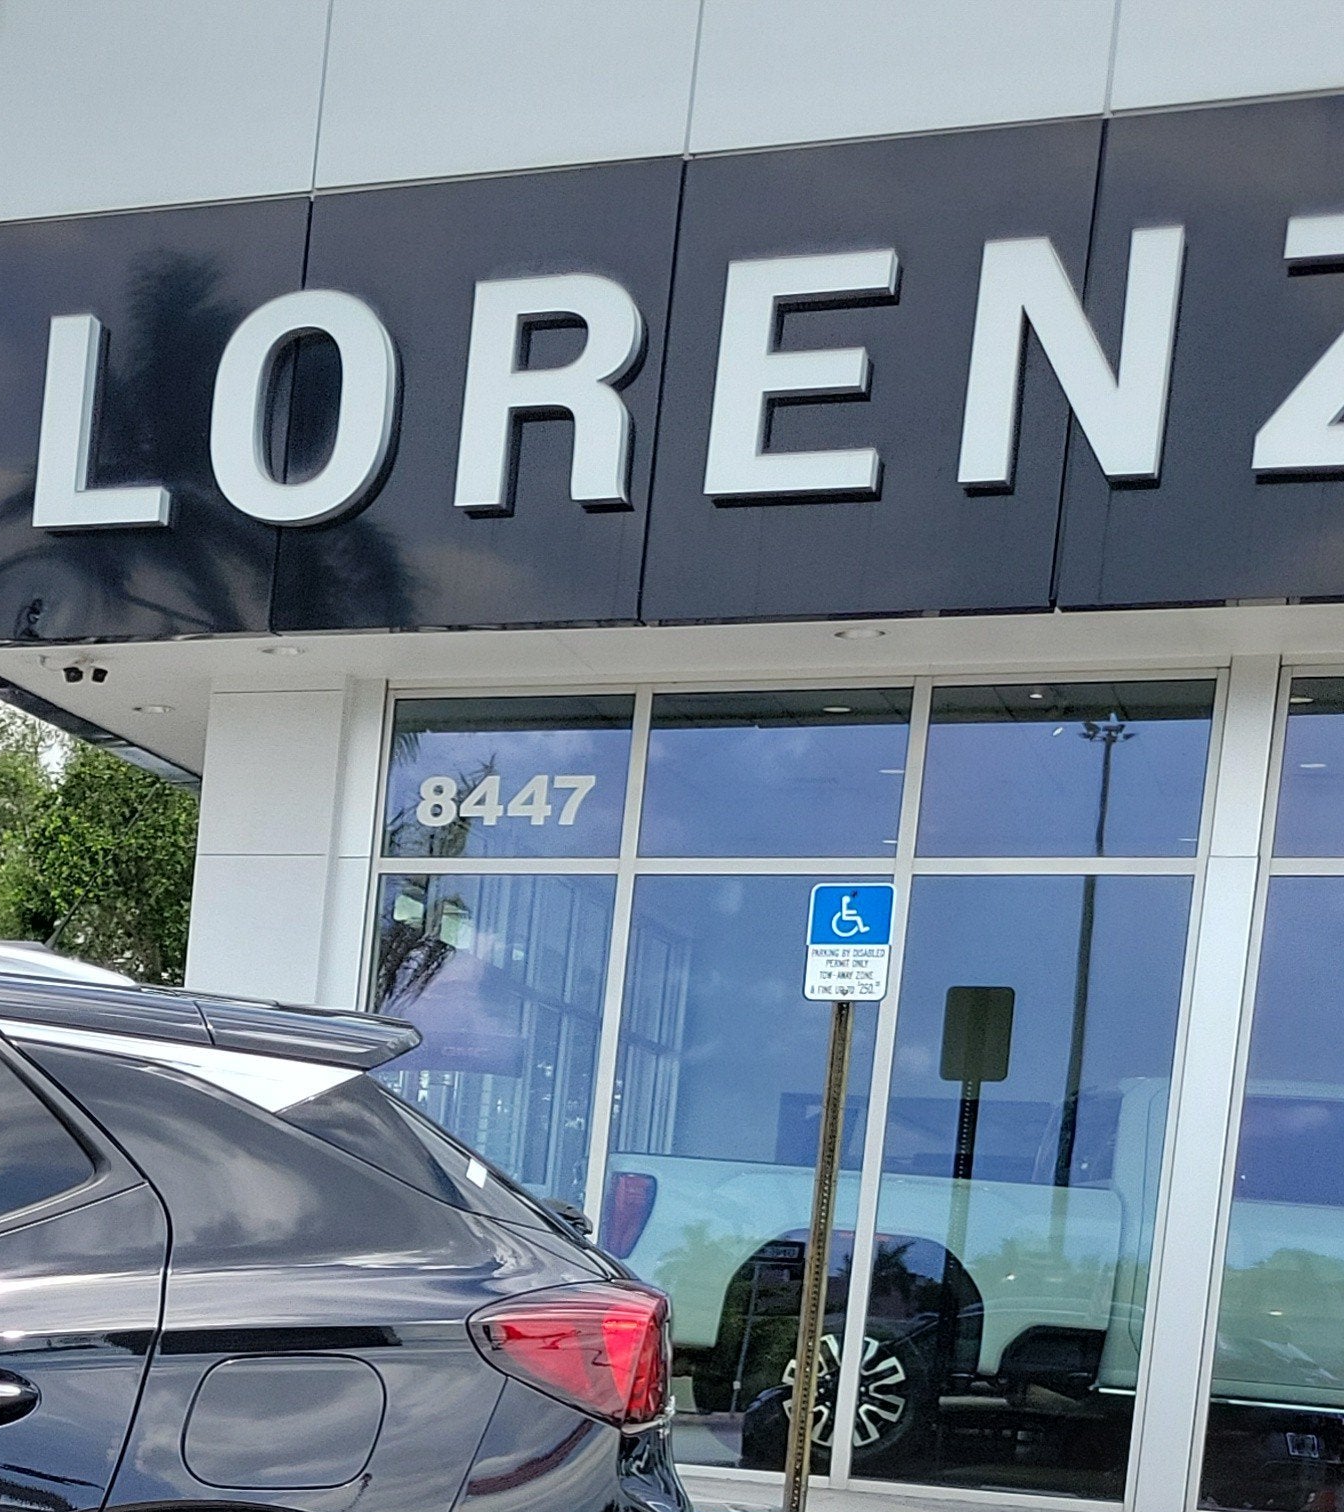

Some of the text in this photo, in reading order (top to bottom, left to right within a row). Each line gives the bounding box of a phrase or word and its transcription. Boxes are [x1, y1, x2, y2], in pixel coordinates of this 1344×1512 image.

[416, 774, 597, 828] 8447
[811, 948, 886, 958] PARKING BY DISABLED
[825, 959, 869, 968] PERMIT ONLY
